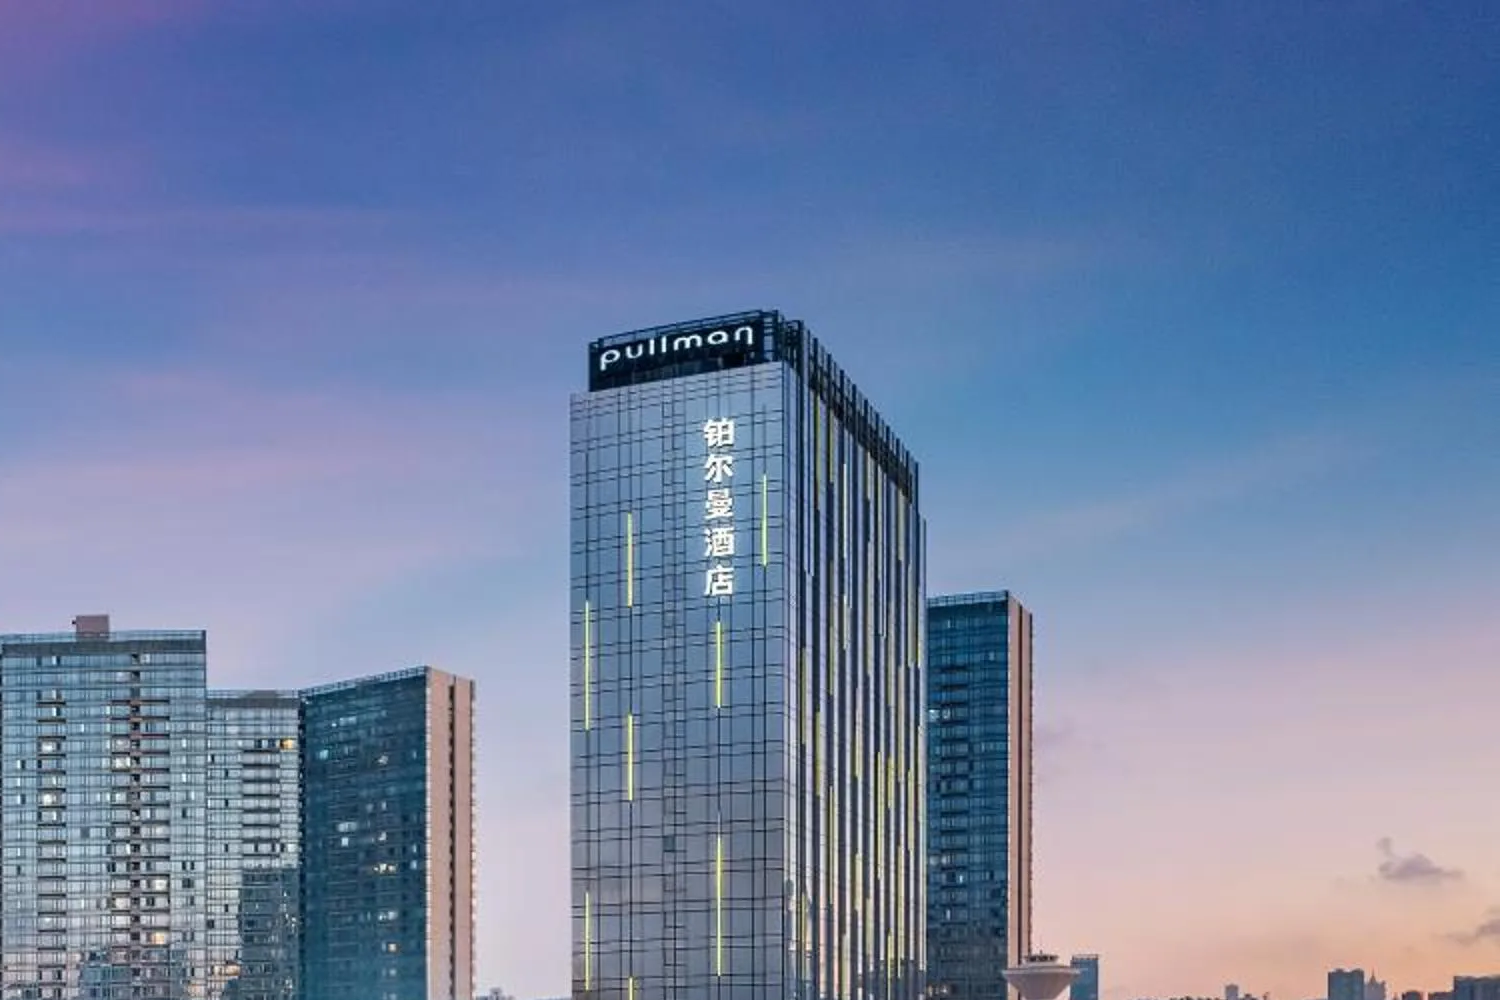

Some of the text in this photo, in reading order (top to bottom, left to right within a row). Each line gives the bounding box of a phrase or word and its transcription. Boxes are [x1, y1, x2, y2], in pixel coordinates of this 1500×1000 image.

[600, 325, 753, 370] pullman
[703, 417, 735, 596] 铂尔曼酒店
